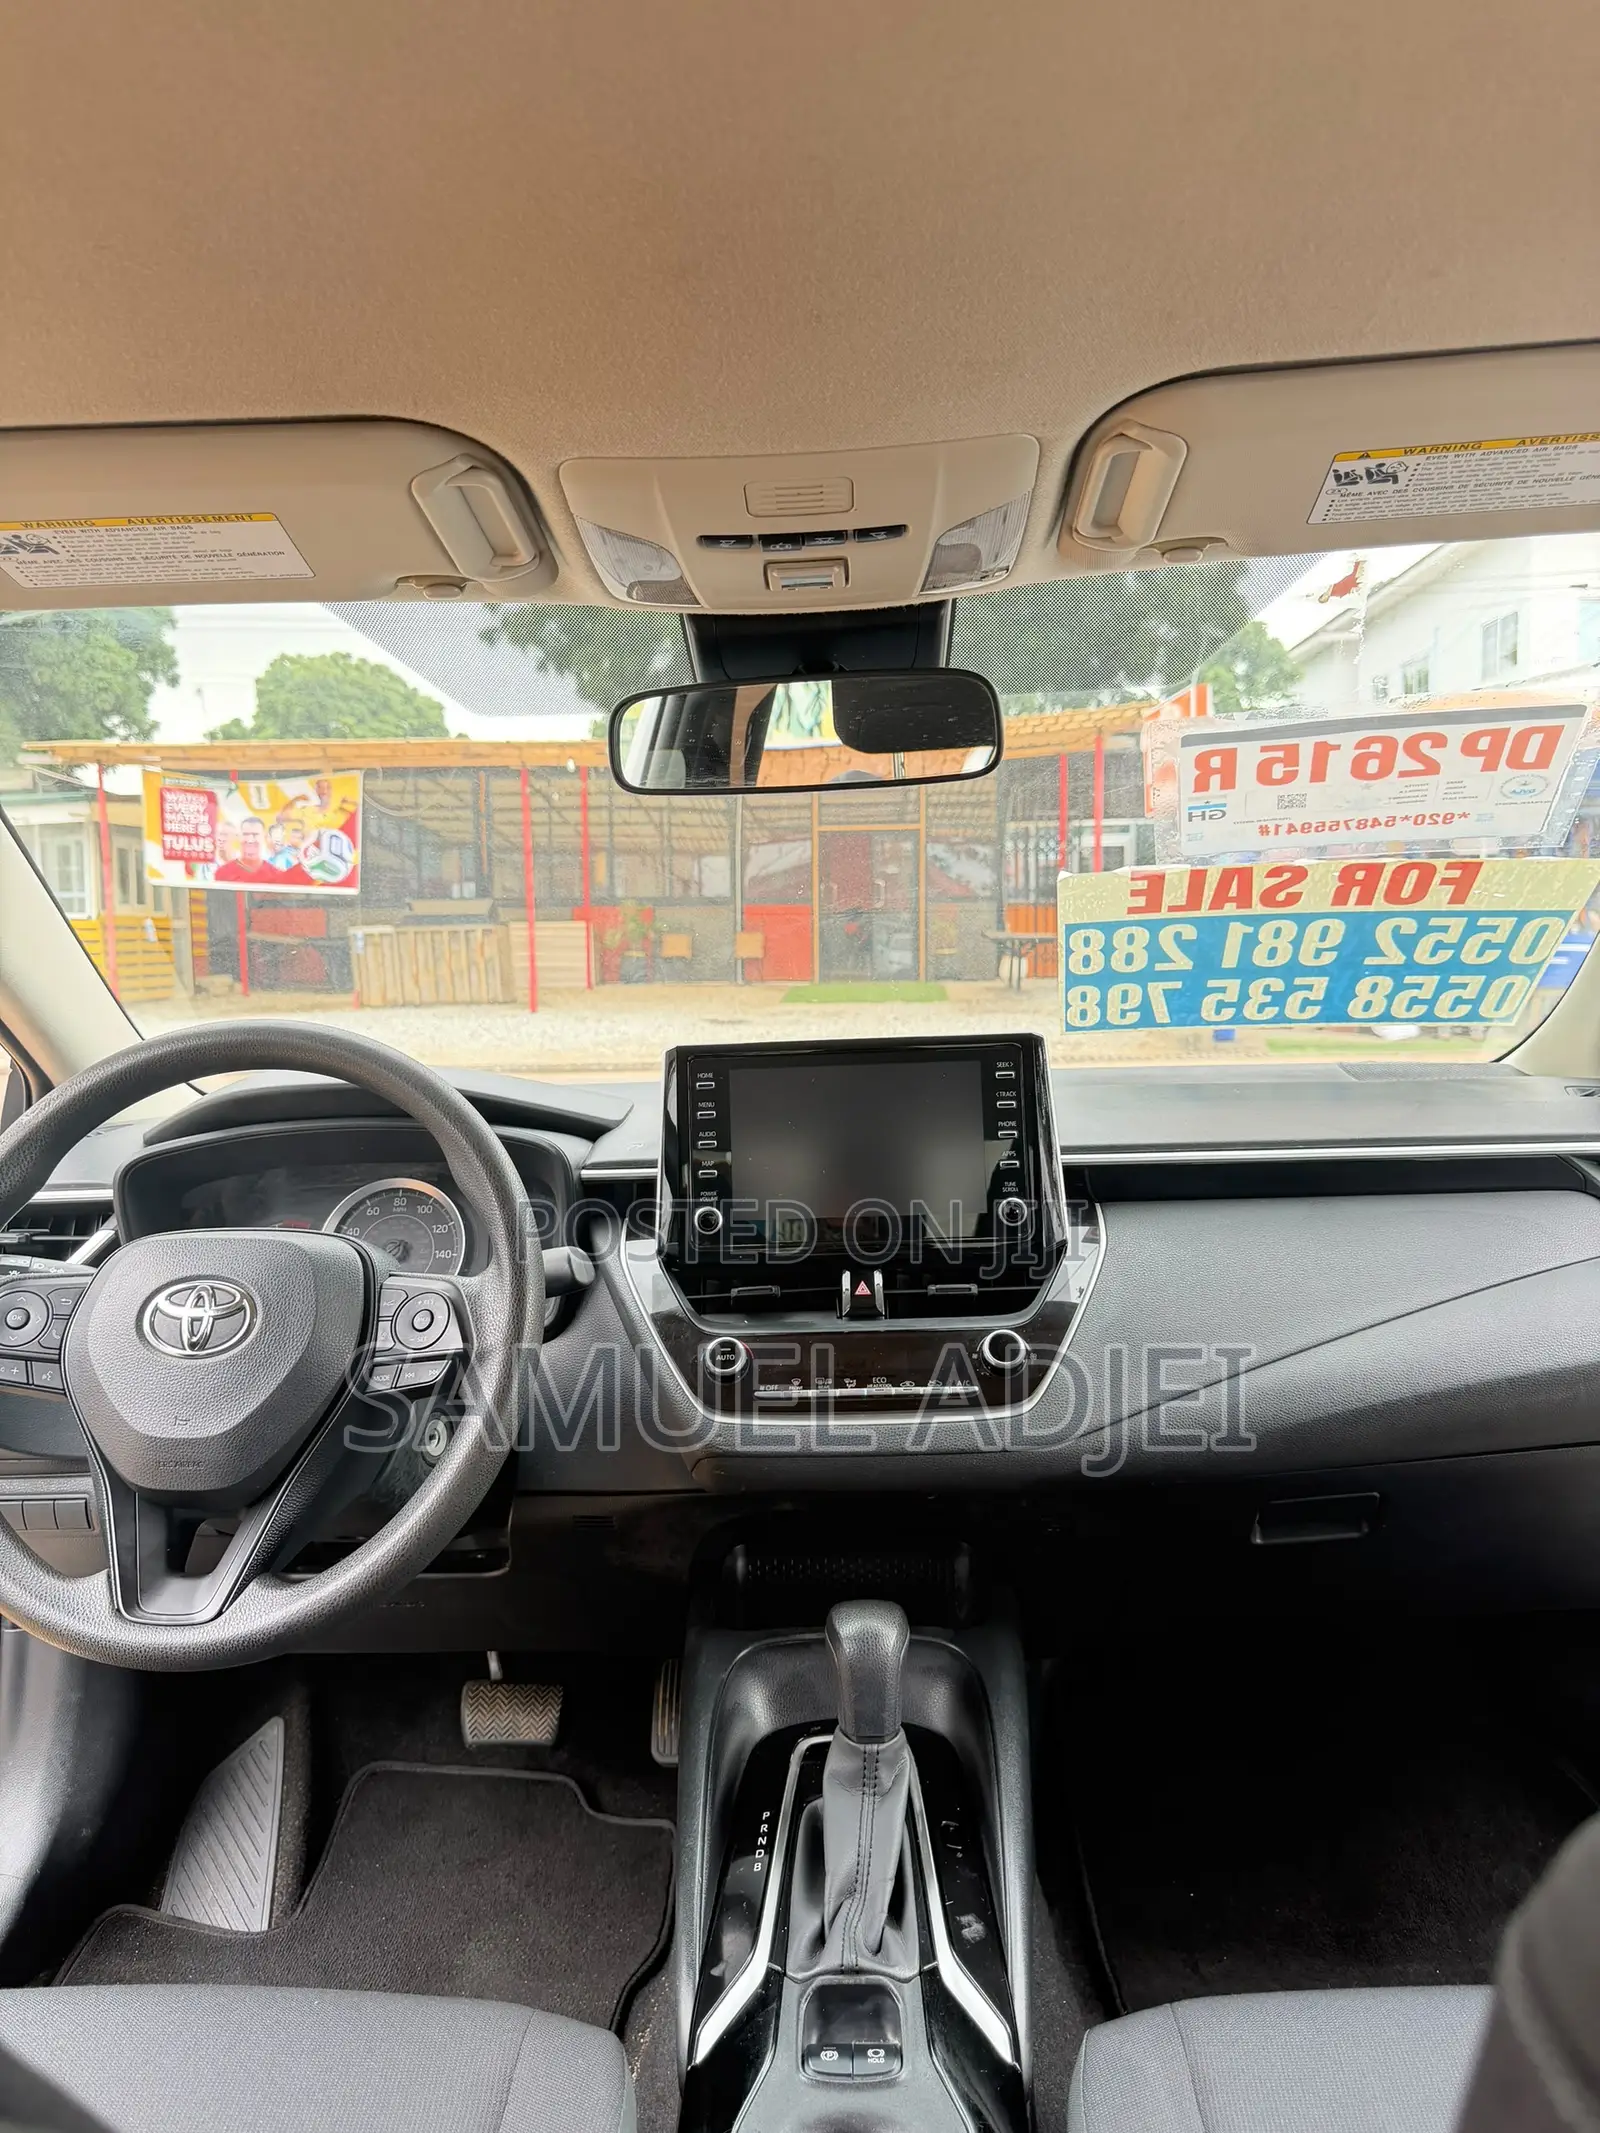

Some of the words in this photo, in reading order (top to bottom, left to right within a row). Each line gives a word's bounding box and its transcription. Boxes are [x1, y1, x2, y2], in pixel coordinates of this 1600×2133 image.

[1403, 442, 1483, 455] WARNING
[1480, 448, 1529, 457] ADVANCED
[20, 519, 96, 529] WARNING
[126, 514, 255, 526] AVERTISSEMENT
[163, 834, 215, 852] TULUS
[393, 1197, 407, 1206] 80
[366, 1207, 380, 1216] 60
[416, 1205, 433, 1214] 100
[347, 1226, 360, 1236] 40
[431, 1224, 449, 1233] 120
[435, 1249, 452, 1259] 140
[373, 1374, 391, 1382] MODE
[872, 1376, 888, 1384] ECO
[762, 1811, 770, 1820] P
[760, 1824, 769, 1833] R
[757, 1836, 767, 1846] N
[755, 1849, 765, 1859] D
